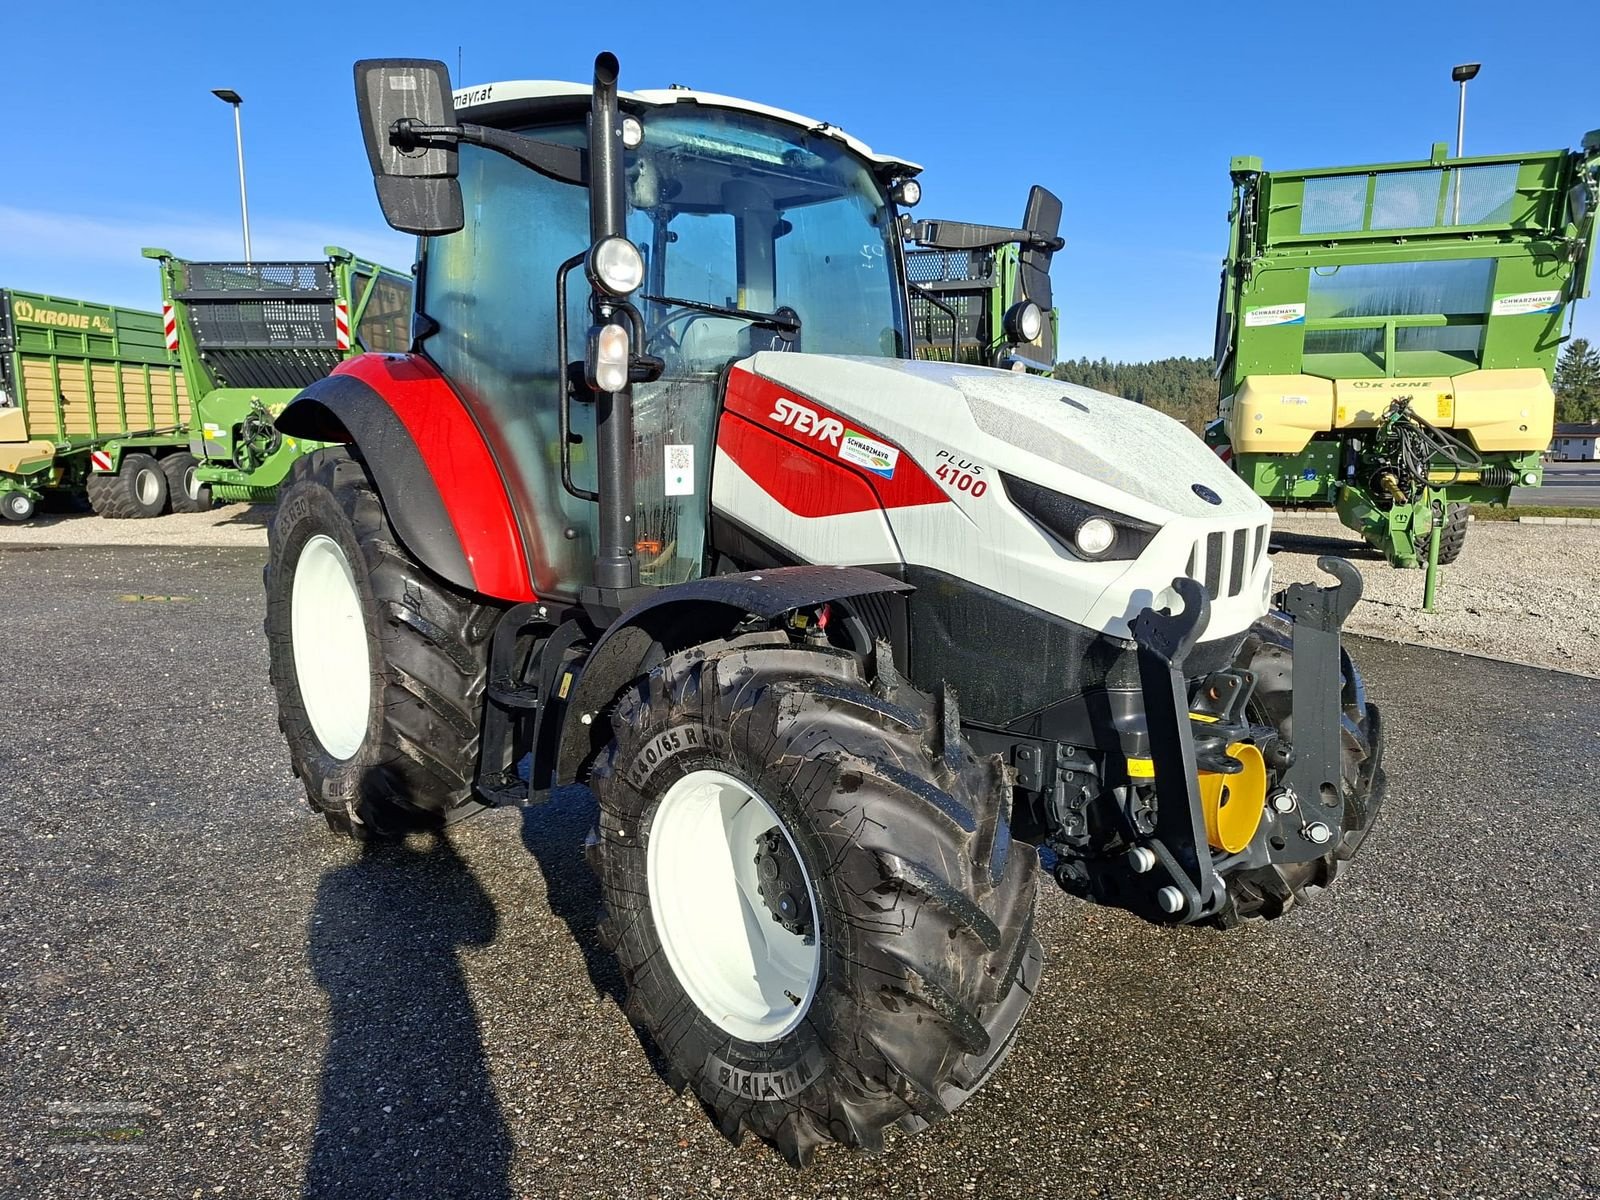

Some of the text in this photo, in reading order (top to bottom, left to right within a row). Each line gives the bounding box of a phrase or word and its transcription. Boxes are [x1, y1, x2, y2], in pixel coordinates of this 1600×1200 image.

[34, 308, 90, 329] KRONE
[769, 398, 844, 447] STEYR
[847, 437, 889, 460] SCHWARZMAYR
[935, 450, 985, 475] PLUS
[935, 463, 988, 498] 4100
[631, 731, 681, 785] 440/65
[685, 727, 698, 745] R
[718, 1060, 813, 1097] MULTIBIB
